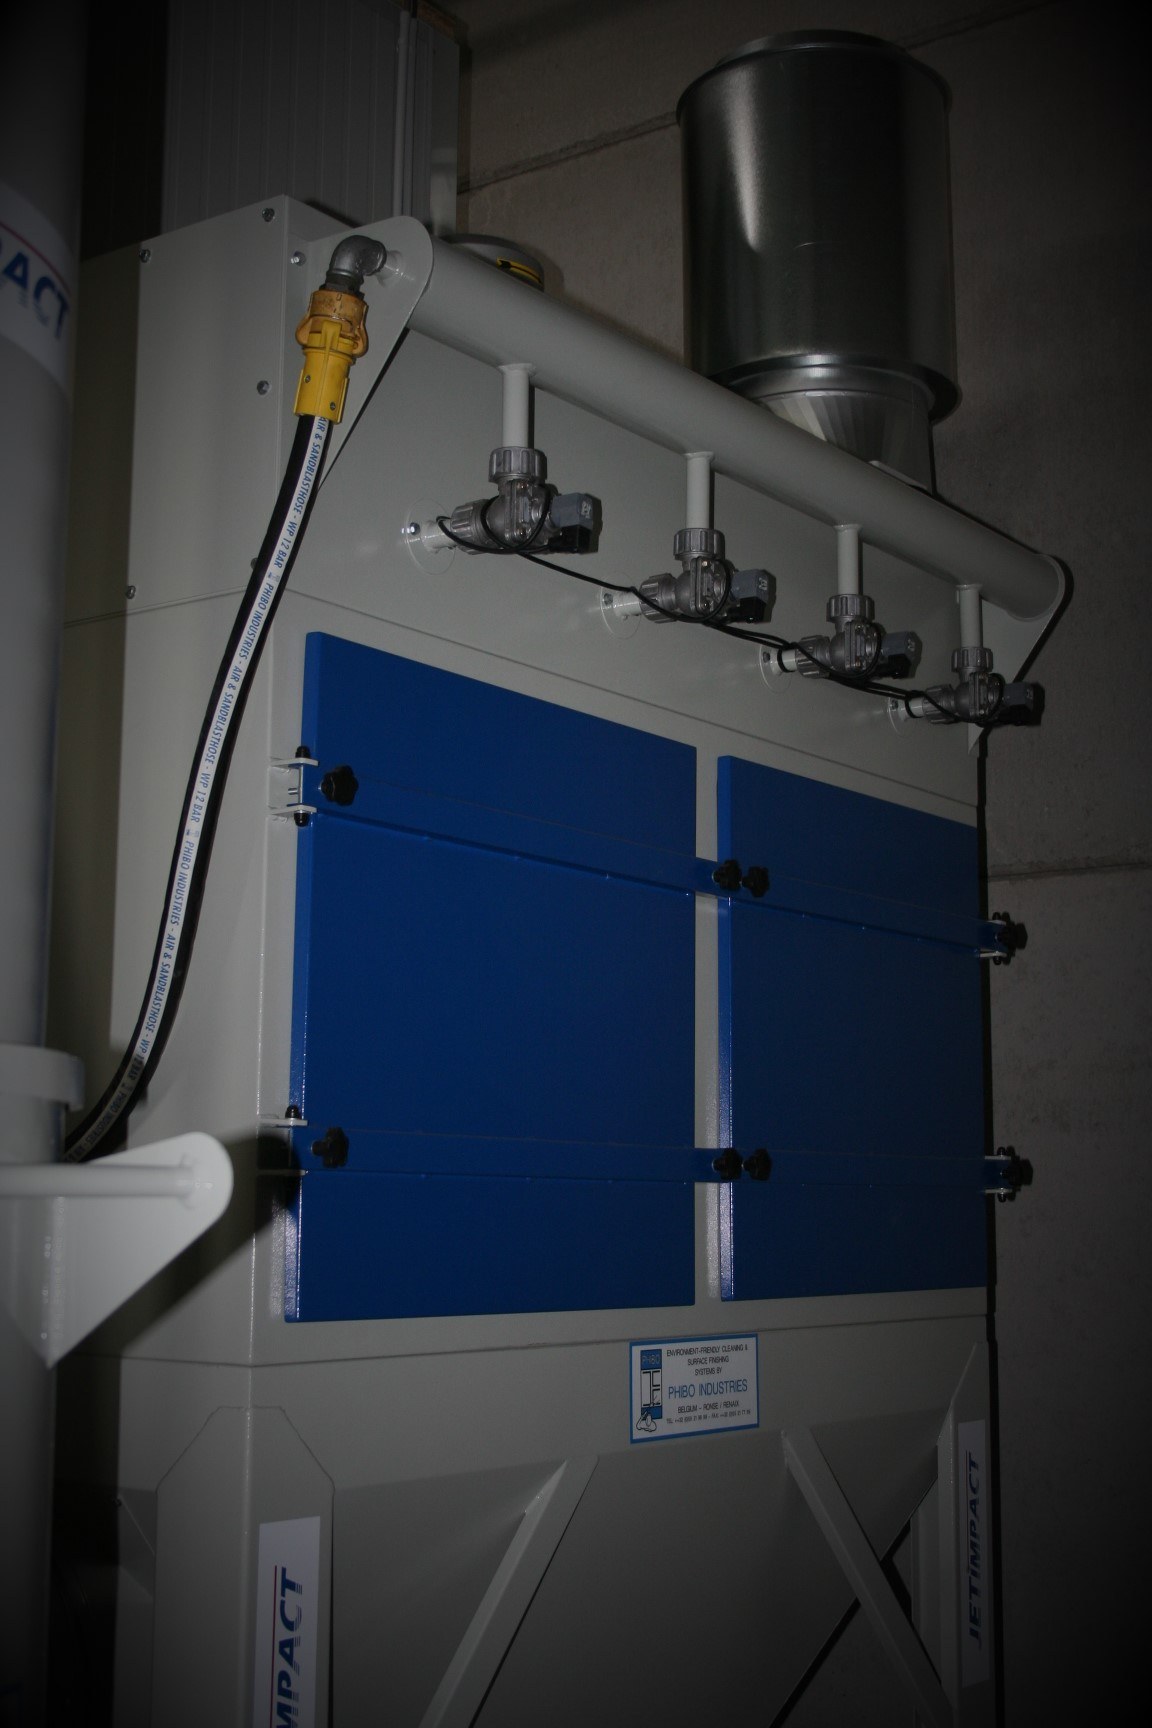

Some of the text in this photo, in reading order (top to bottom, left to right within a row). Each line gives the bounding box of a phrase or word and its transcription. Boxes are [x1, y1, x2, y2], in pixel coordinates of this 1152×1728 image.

[0, 237, 69, 340] ACT
[316, 417, 327, 432] AIR
[314, 432, 322, 440] &
[293, 442, 321, 514] SANDBLASTHOSE
[286, 520, 298, 537] WP
[280, 538, 291, 549] 12
[274, 549, 286, 569] BAR
[258, 582, 274, 610] PHIBO
[238, 610, 264, 660] INDUSTRIES
[230, 665, 243, 683] AIR
[227, 682, 236, 690] &
[205, 692, 234, 765] SANDBLASTHOSE
[200, 772, 211, 789] WP
[195, 790, 207, 802] 12
[190, 803, 203, 823] BAR
[180, 840, 195, 870] PHIBO
[170, 872, 188, 926] INDUSTRIES
[164, 933, 176, 950] AIR
[163, 952, 172, 960] &
[145, 962, 171, 1033] SANDBLASTHOSE
[140, 1039, 151, 1054] WP
[667, 1345, 720, 1356] ENVIRONMENT-FRIENDLY
[721, 1344, 744, 1352] CLEANING
[687, 1356, 730, 1366] SURFACE FINISHING
[694, 1368, 716, 1376] SYSTEMS
[669, 1380, 747, 1399] PHIBO INDUSTRIES
[678, 1404, 698, 1414] BELGIUM
[703, 1402, 719, 1412] RONSE
